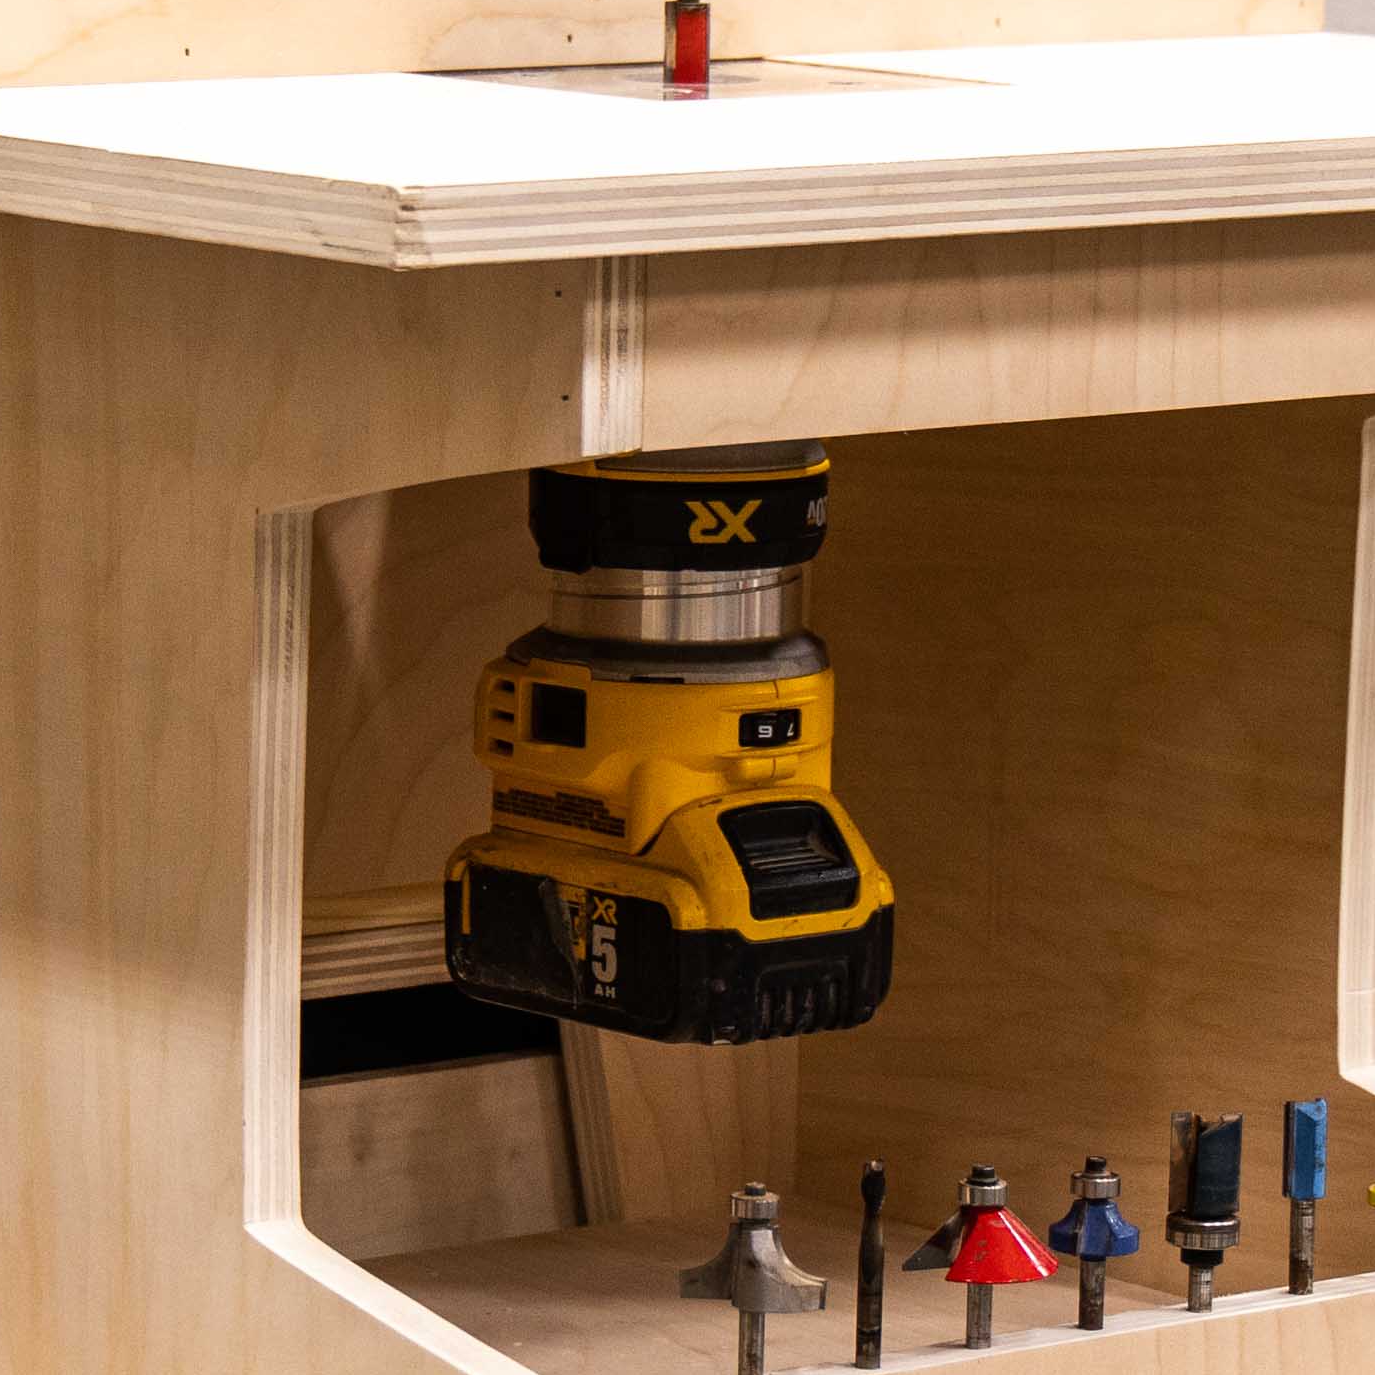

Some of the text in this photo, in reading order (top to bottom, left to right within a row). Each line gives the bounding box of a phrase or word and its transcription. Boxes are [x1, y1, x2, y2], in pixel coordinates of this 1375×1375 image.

[683, 499, 763, 544] XR
[591, 895, 619, 926] XR
[591, 923, 618, 984] 5
